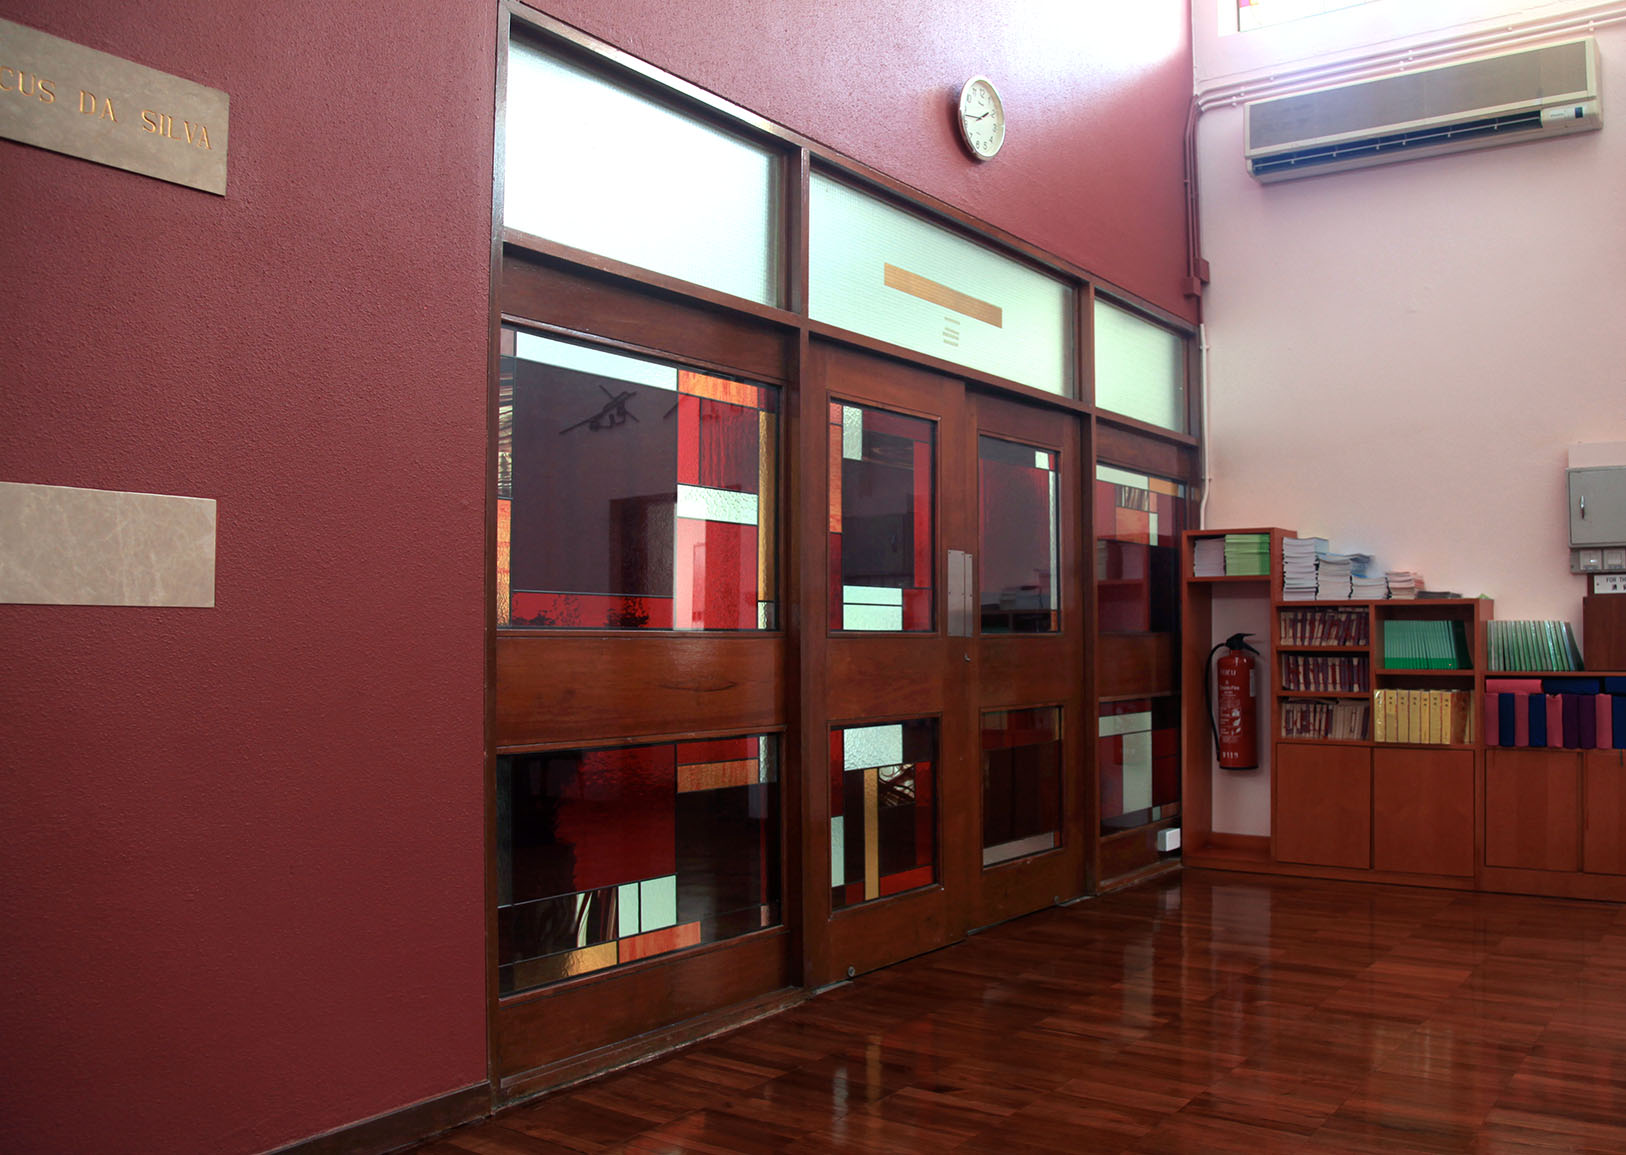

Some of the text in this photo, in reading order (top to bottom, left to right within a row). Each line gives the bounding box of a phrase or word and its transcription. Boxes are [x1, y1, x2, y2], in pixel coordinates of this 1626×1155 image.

[0, 65, 212, 150] CUS DA SILVA
